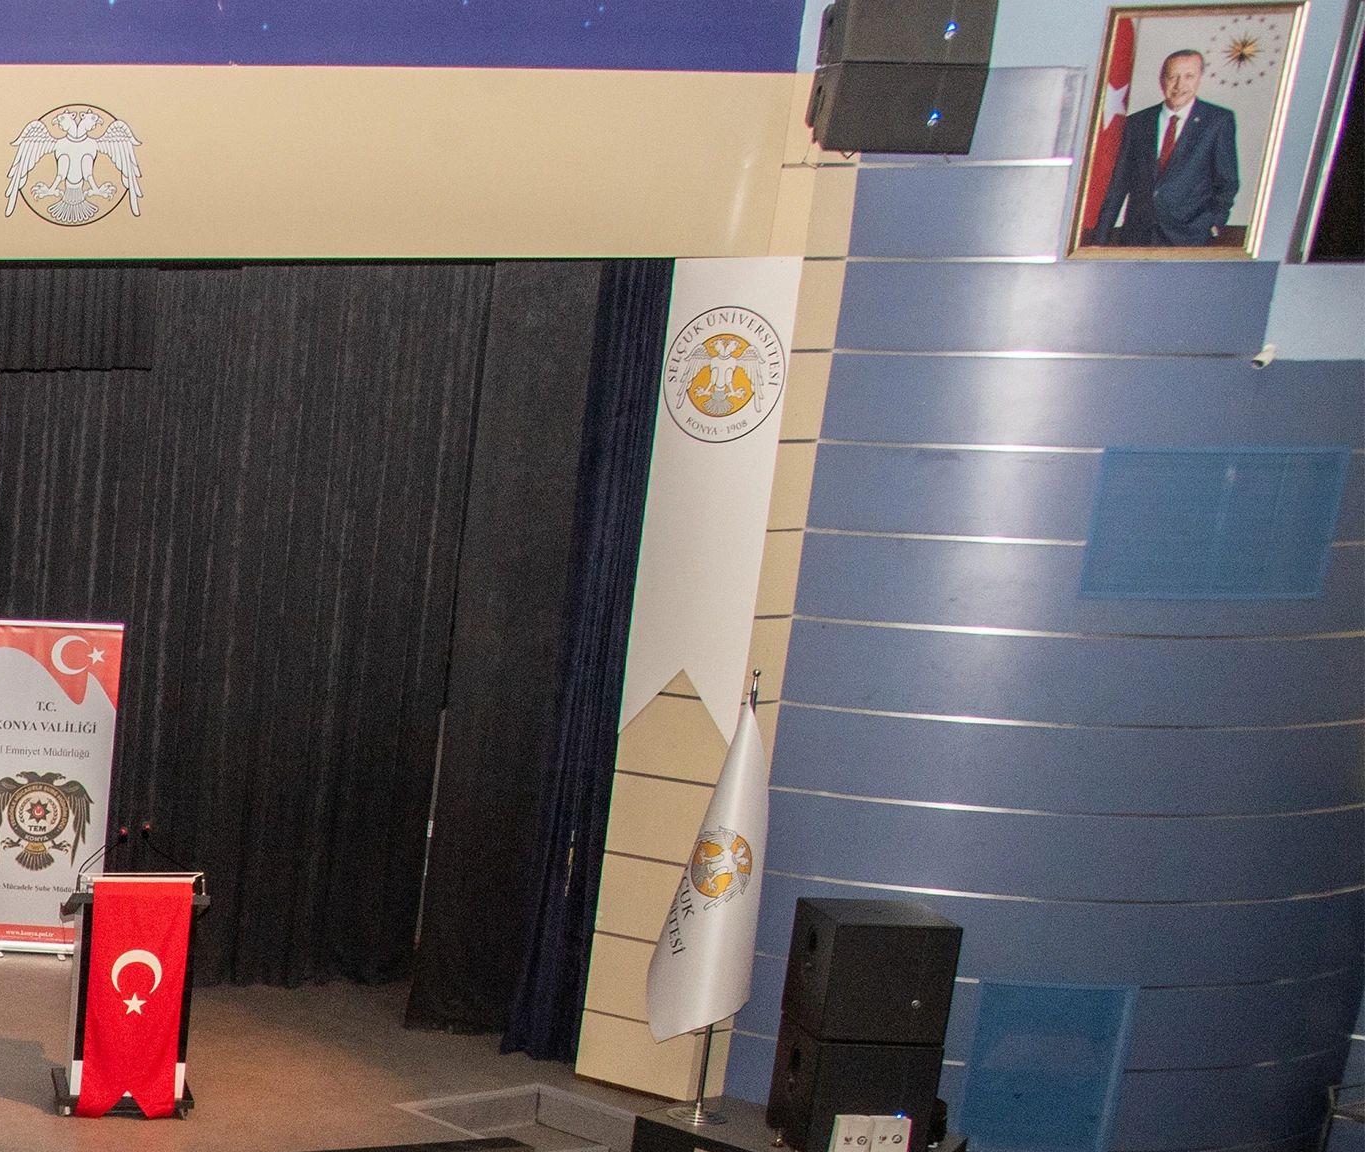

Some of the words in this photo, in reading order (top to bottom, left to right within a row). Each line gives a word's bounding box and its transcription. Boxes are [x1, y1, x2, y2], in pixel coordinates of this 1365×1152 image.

[668, 321, 705, 383] SELÇUK
[706, 311, 781, 388] ÜNİVERSİTESİ
[685, 416, 718, 435] KONYA
[726, 419, 748, 435] 1908
[35, 701, 57, 712] T.C.
[40, 720, 97, 734] VALİLİĞİ
[5, 745, 41, 758] Emniyet
[42, 747, 90, 760] Müdürlüğü
[24, 834, 49, 842] KONYA
